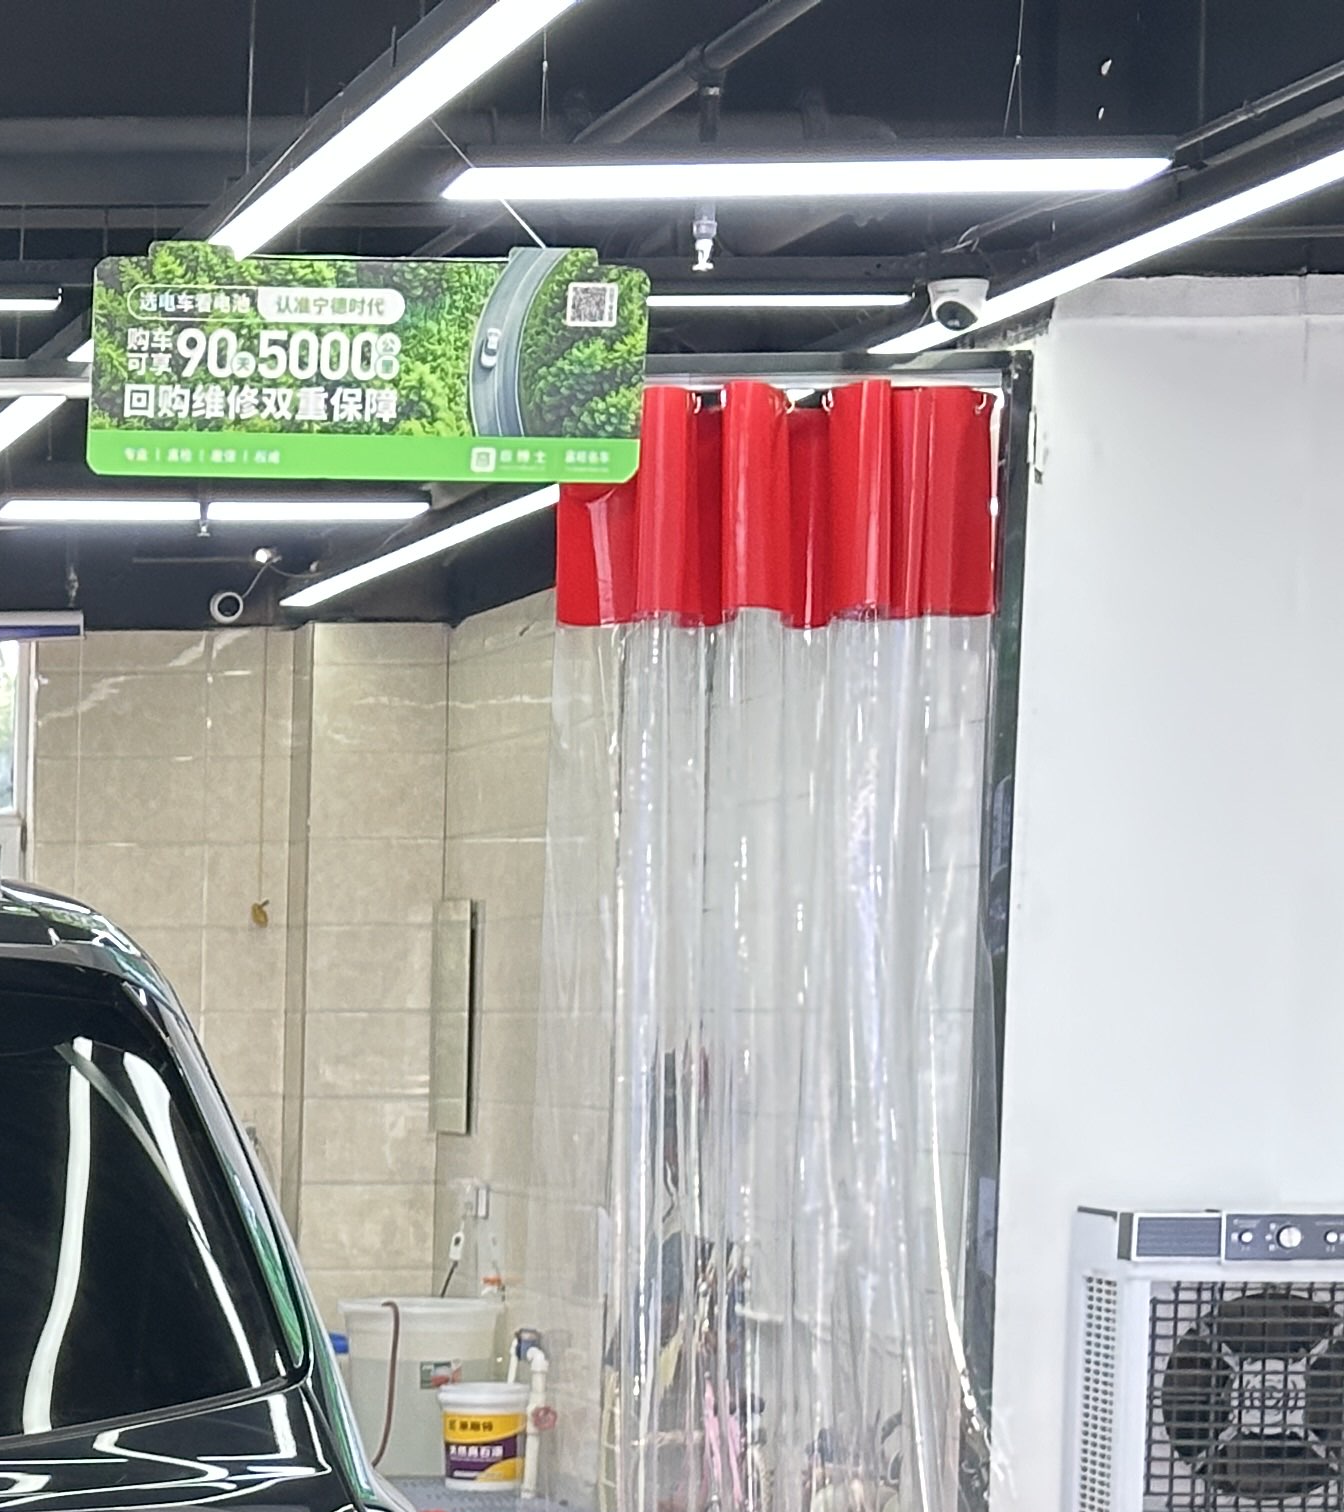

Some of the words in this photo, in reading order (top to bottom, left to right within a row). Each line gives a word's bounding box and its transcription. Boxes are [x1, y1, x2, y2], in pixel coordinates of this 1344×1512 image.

[138, 291, 251, 314] 选电车看电池
[275, 296, 385, 317] 认准宁德时代
[127, 327, 173, 352] 购车
[127, 352, 173, 376] 可享
[123, 383, 398, 423] 回购维修双重保障
